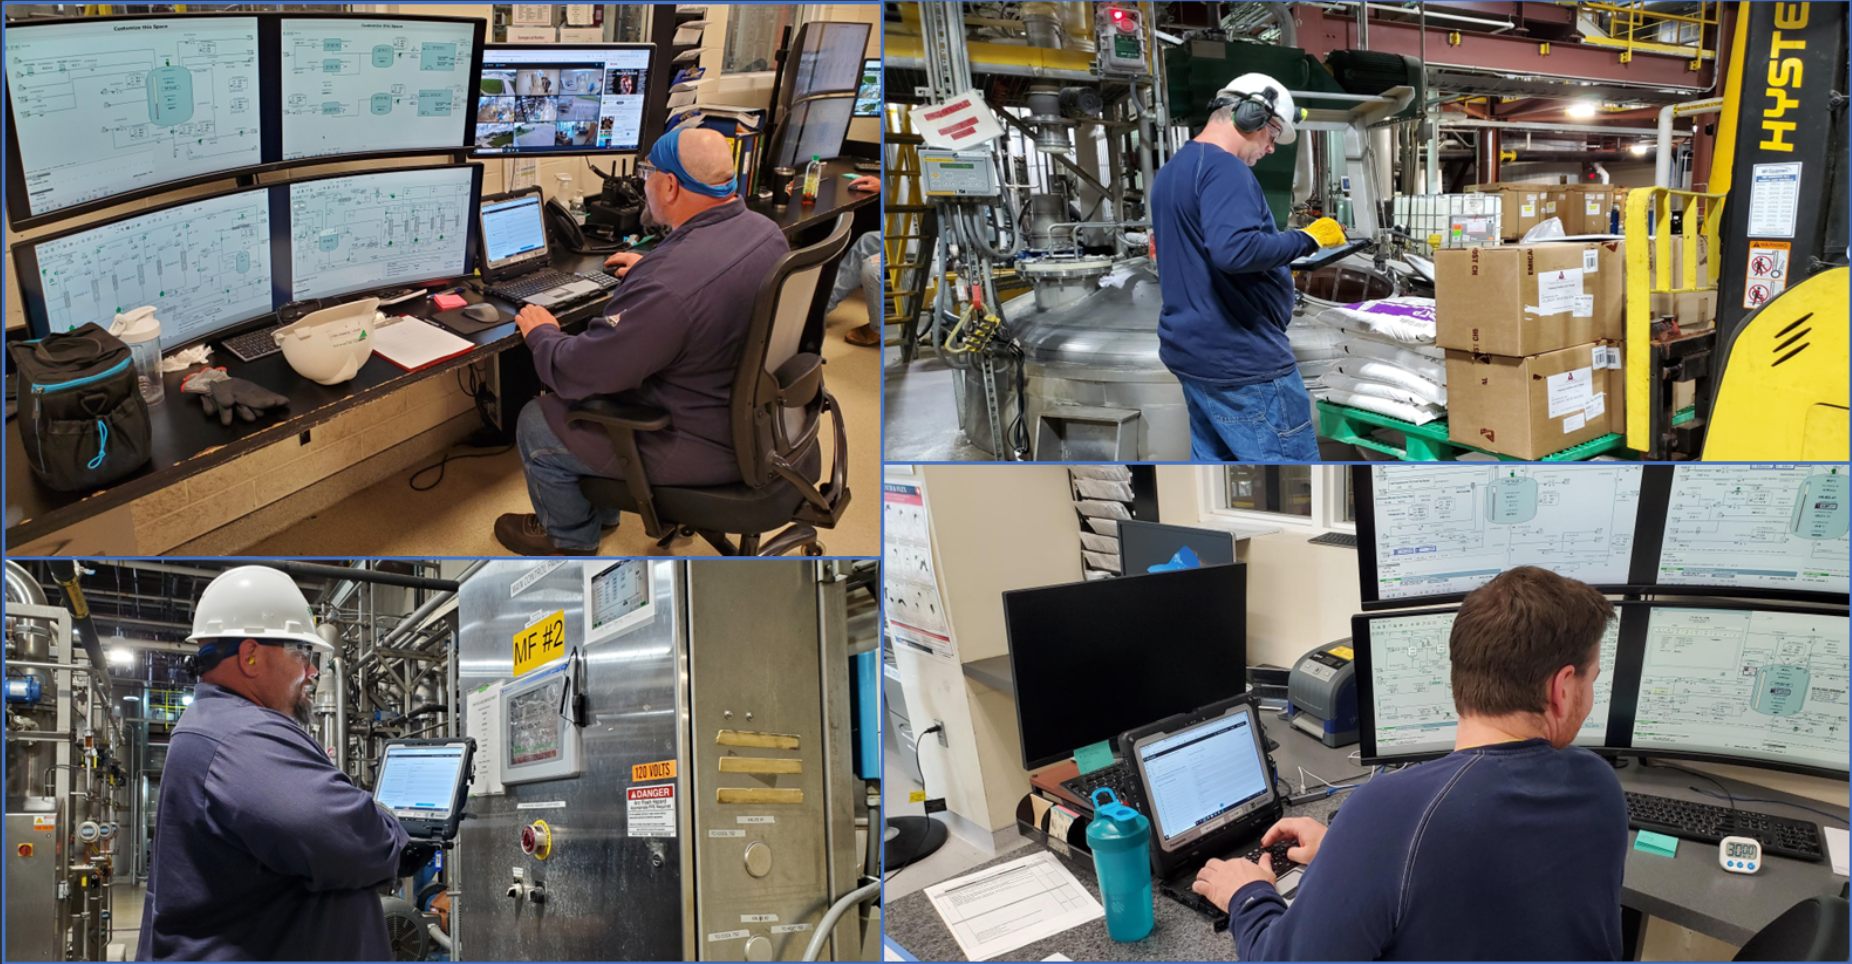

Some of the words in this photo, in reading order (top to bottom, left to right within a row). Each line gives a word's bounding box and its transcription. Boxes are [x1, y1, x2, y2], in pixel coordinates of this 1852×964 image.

[1759, 2, 1810, 152] HYSTE
[524, 565, 547, 584] CONTROL
[515, 631, 537, 666] MF
[542, 619, 563, 654] #2
[635, 765, 647, 779] 120
[649, 762, 671, 778] VOLTS
[637, 788, 670, 797] DANGER
